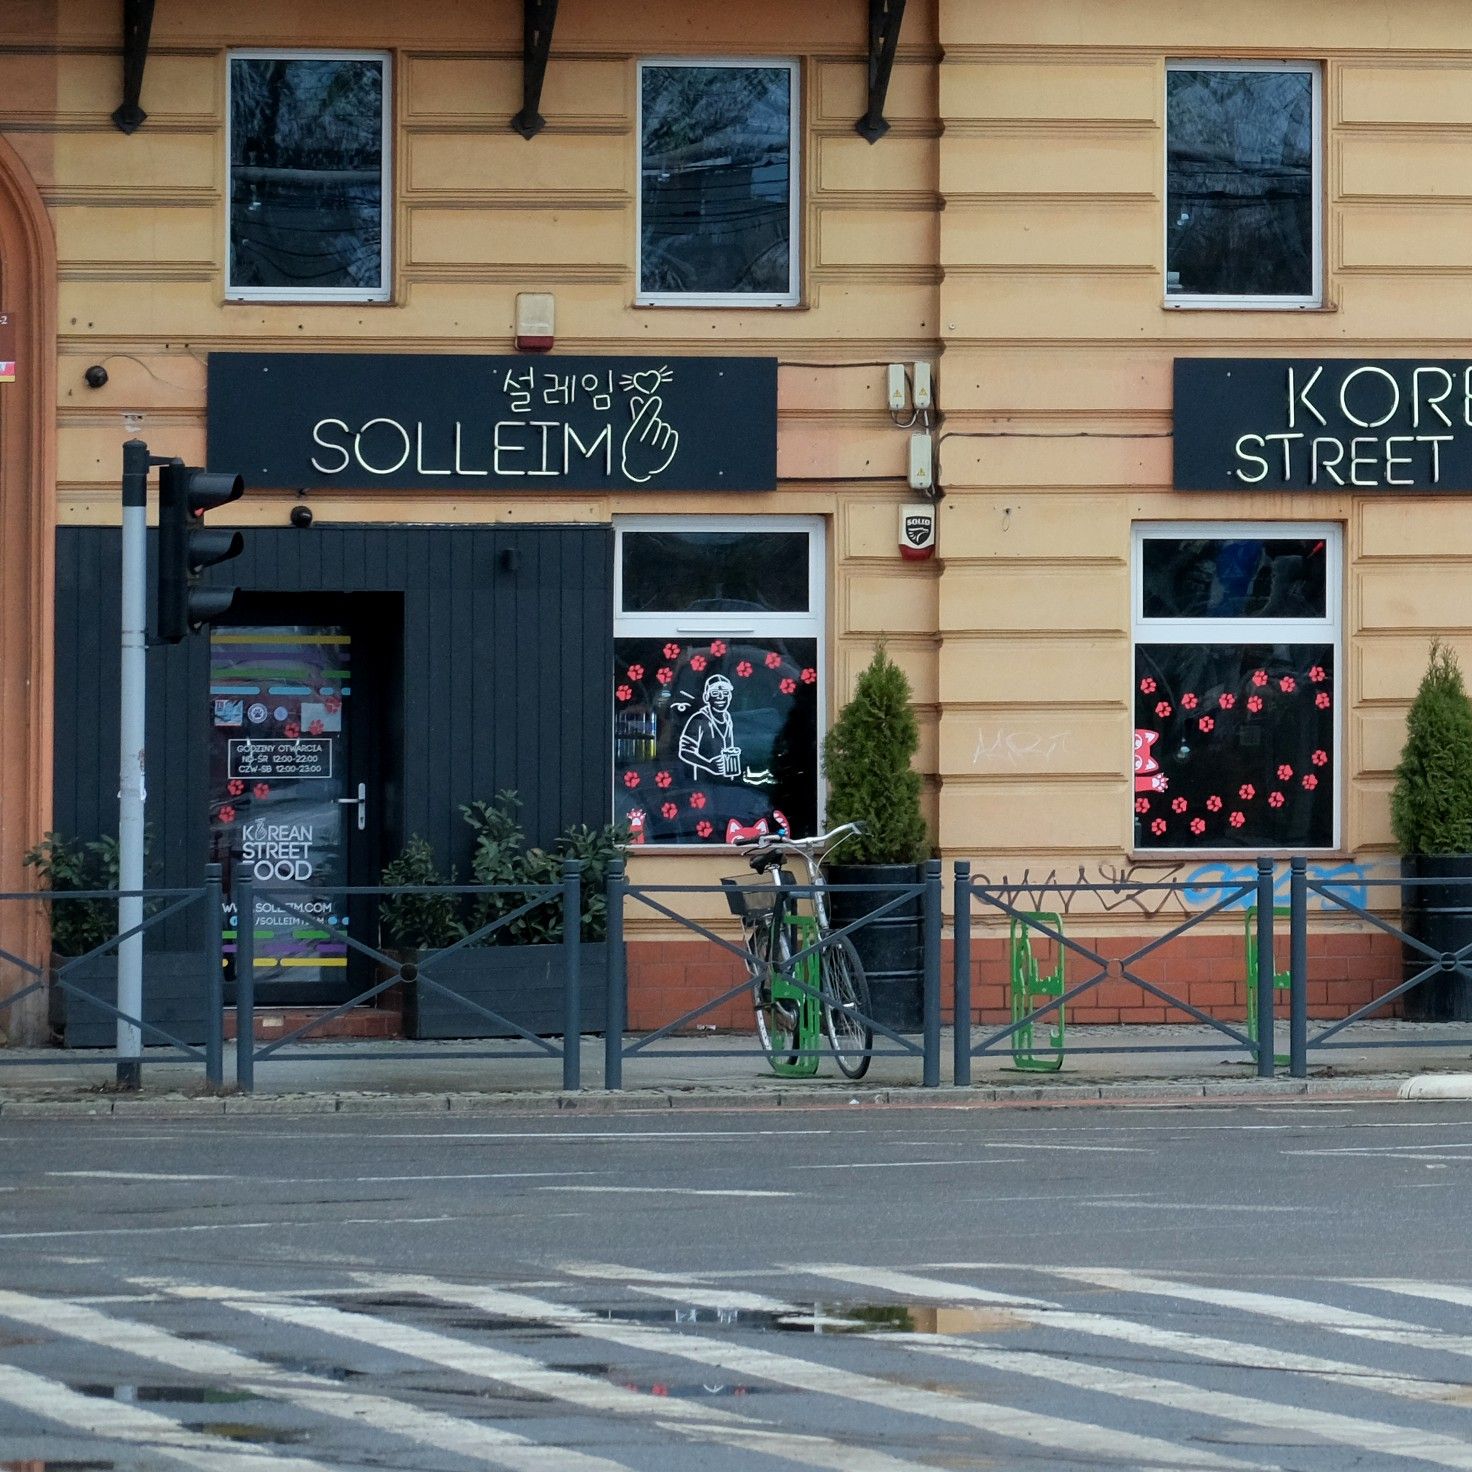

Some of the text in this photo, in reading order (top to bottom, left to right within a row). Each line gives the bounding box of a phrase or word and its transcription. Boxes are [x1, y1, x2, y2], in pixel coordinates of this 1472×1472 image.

[503, 367, 613, 412] 설레임
[311, 418, 613, 475] SOLLEIM
[1235, 433, 1454, 485] STREET
[907, 518, 931, 526] SOLID
[242, 842, 313, 859] STREET
[242, 860, 313, 881] OOD
